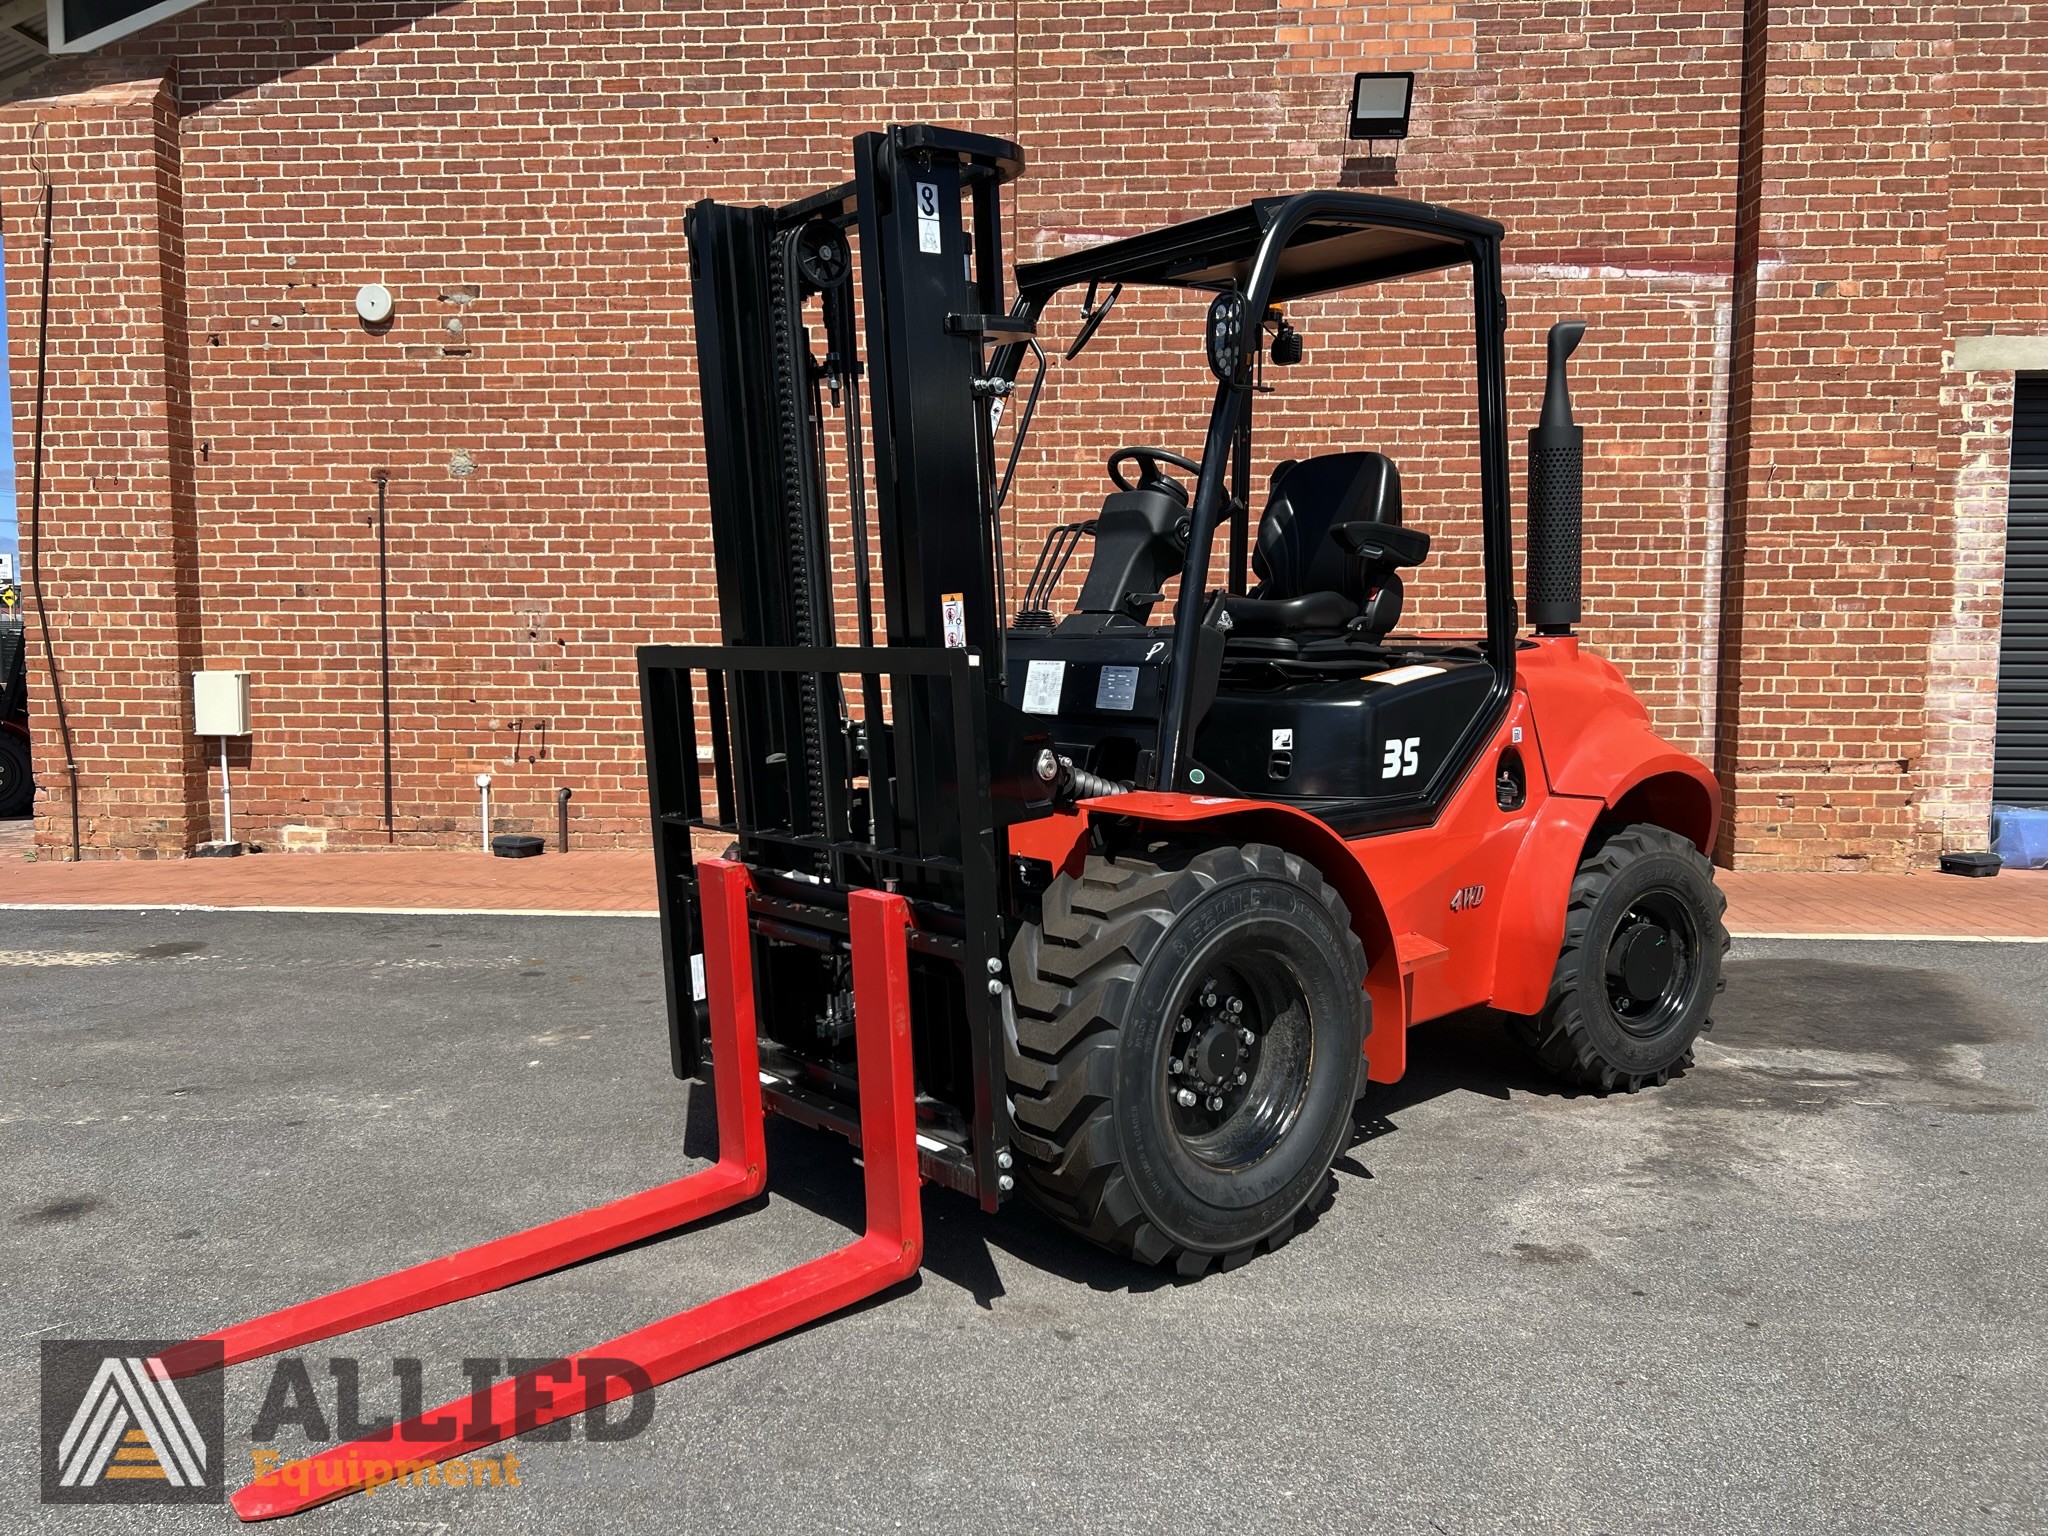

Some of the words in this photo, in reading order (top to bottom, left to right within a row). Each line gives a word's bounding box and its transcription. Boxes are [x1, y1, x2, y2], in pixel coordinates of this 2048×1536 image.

[1145, 642, 1165, 660] P
[1382, 737, 1420, 779] 35
[1450, 885, 1486, 912] 4WD
